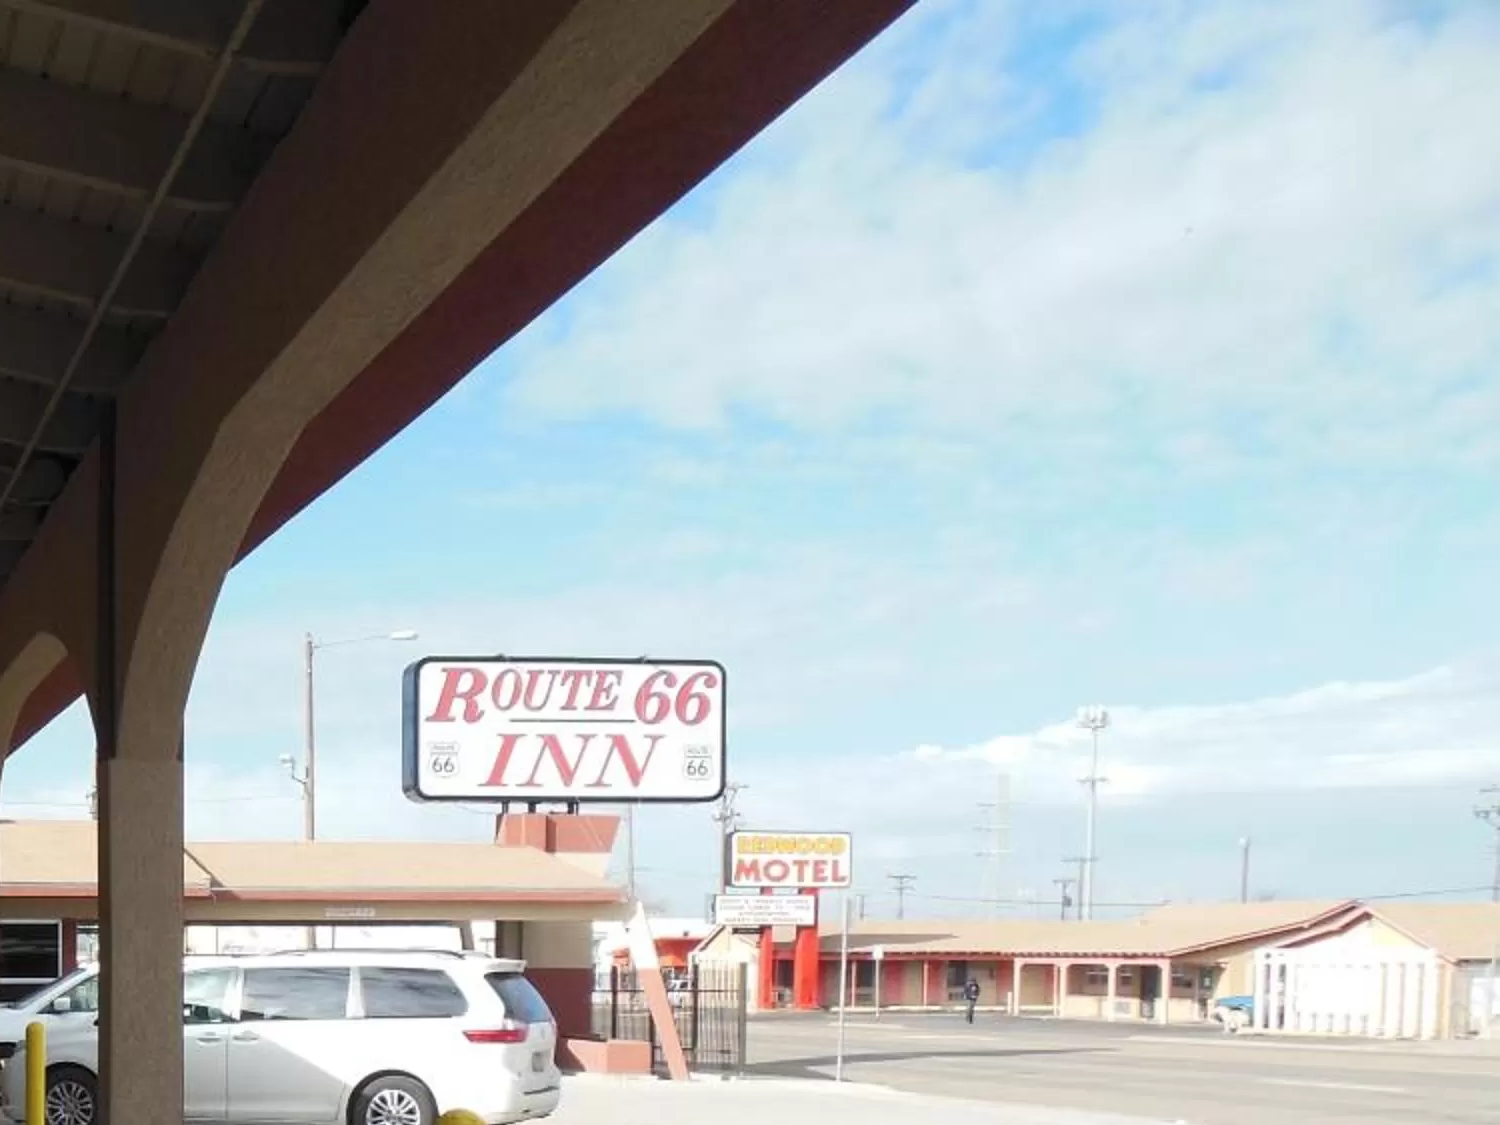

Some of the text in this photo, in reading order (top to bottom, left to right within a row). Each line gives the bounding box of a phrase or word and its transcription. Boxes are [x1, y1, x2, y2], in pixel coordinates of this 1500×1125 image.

[425, 667, 718, 726] ROUTE 66
[431, 757, 455, 773] 66
[478, 733, 666, 788] INN
[687, 760, 708, 776] 66
[734, 859, 848, 883] MOTEL
